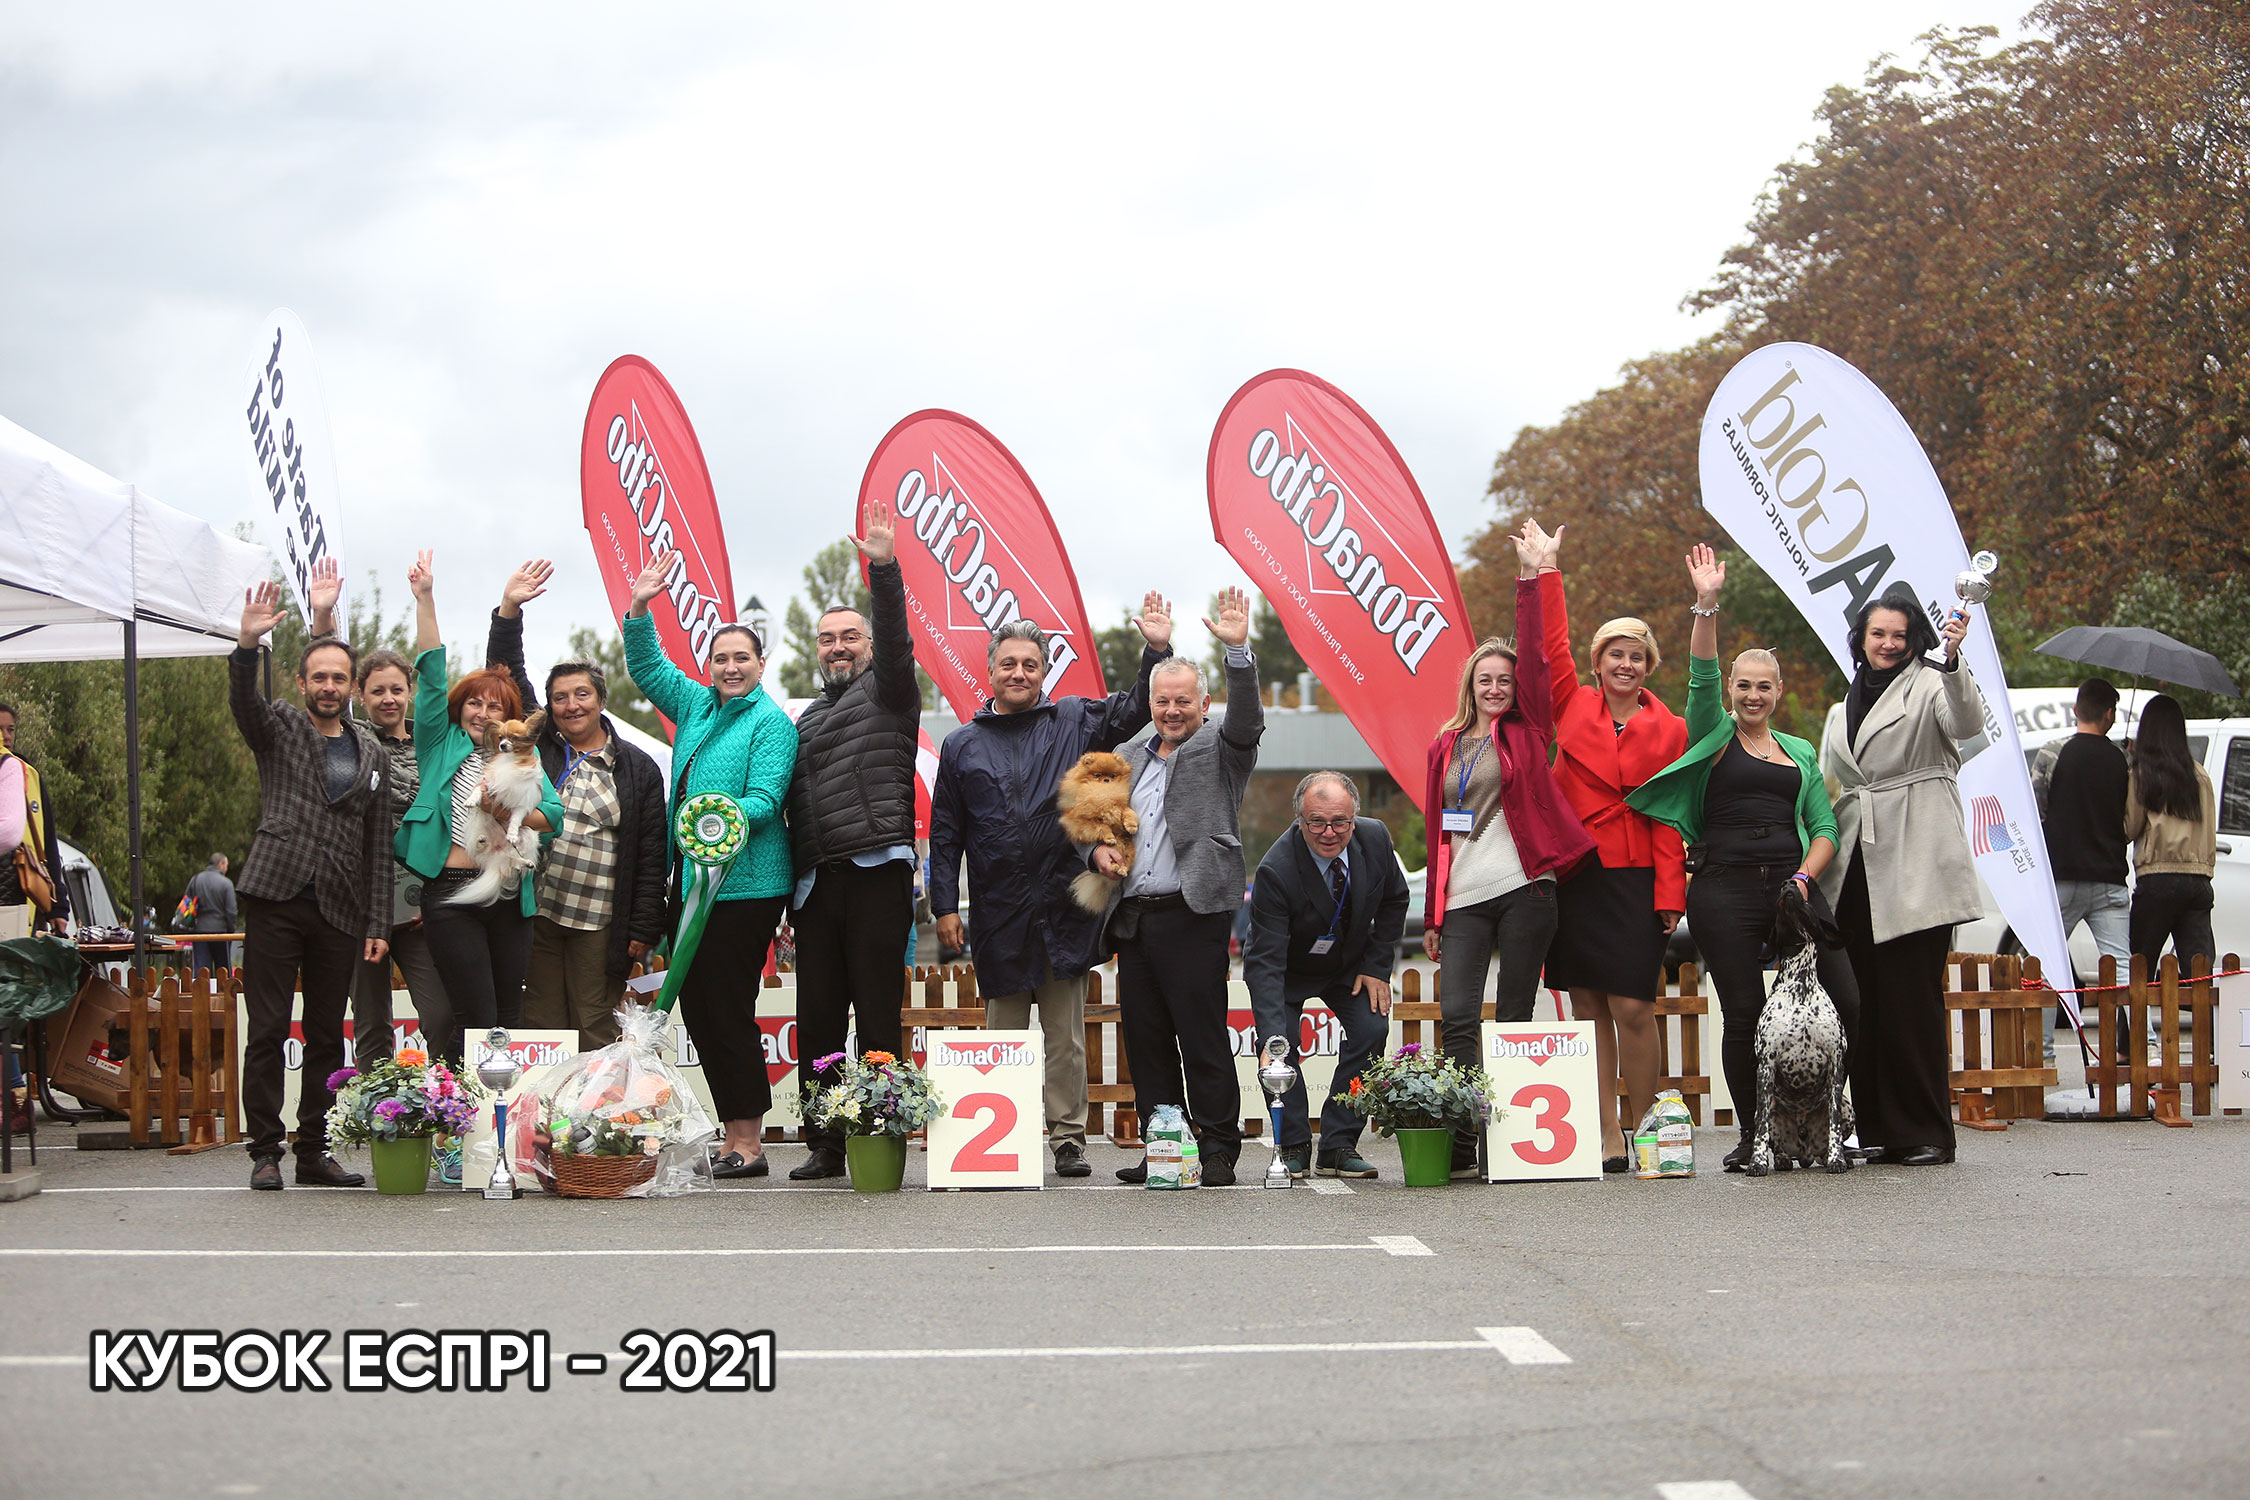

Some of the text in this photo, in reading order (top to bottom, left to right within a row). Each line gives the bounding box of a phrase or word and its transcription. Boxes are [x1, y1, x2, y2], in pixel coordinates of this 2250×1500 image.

[472, 1043, 571, 1067] BaCibo
[934, 1042, 1035, 1067] BonaCibo
[1489, 1032, 1590, 1060] BonaCibo
[950, 1092, 1019, 1173] 2
[1509, 1084, 1578, 1166] 3
